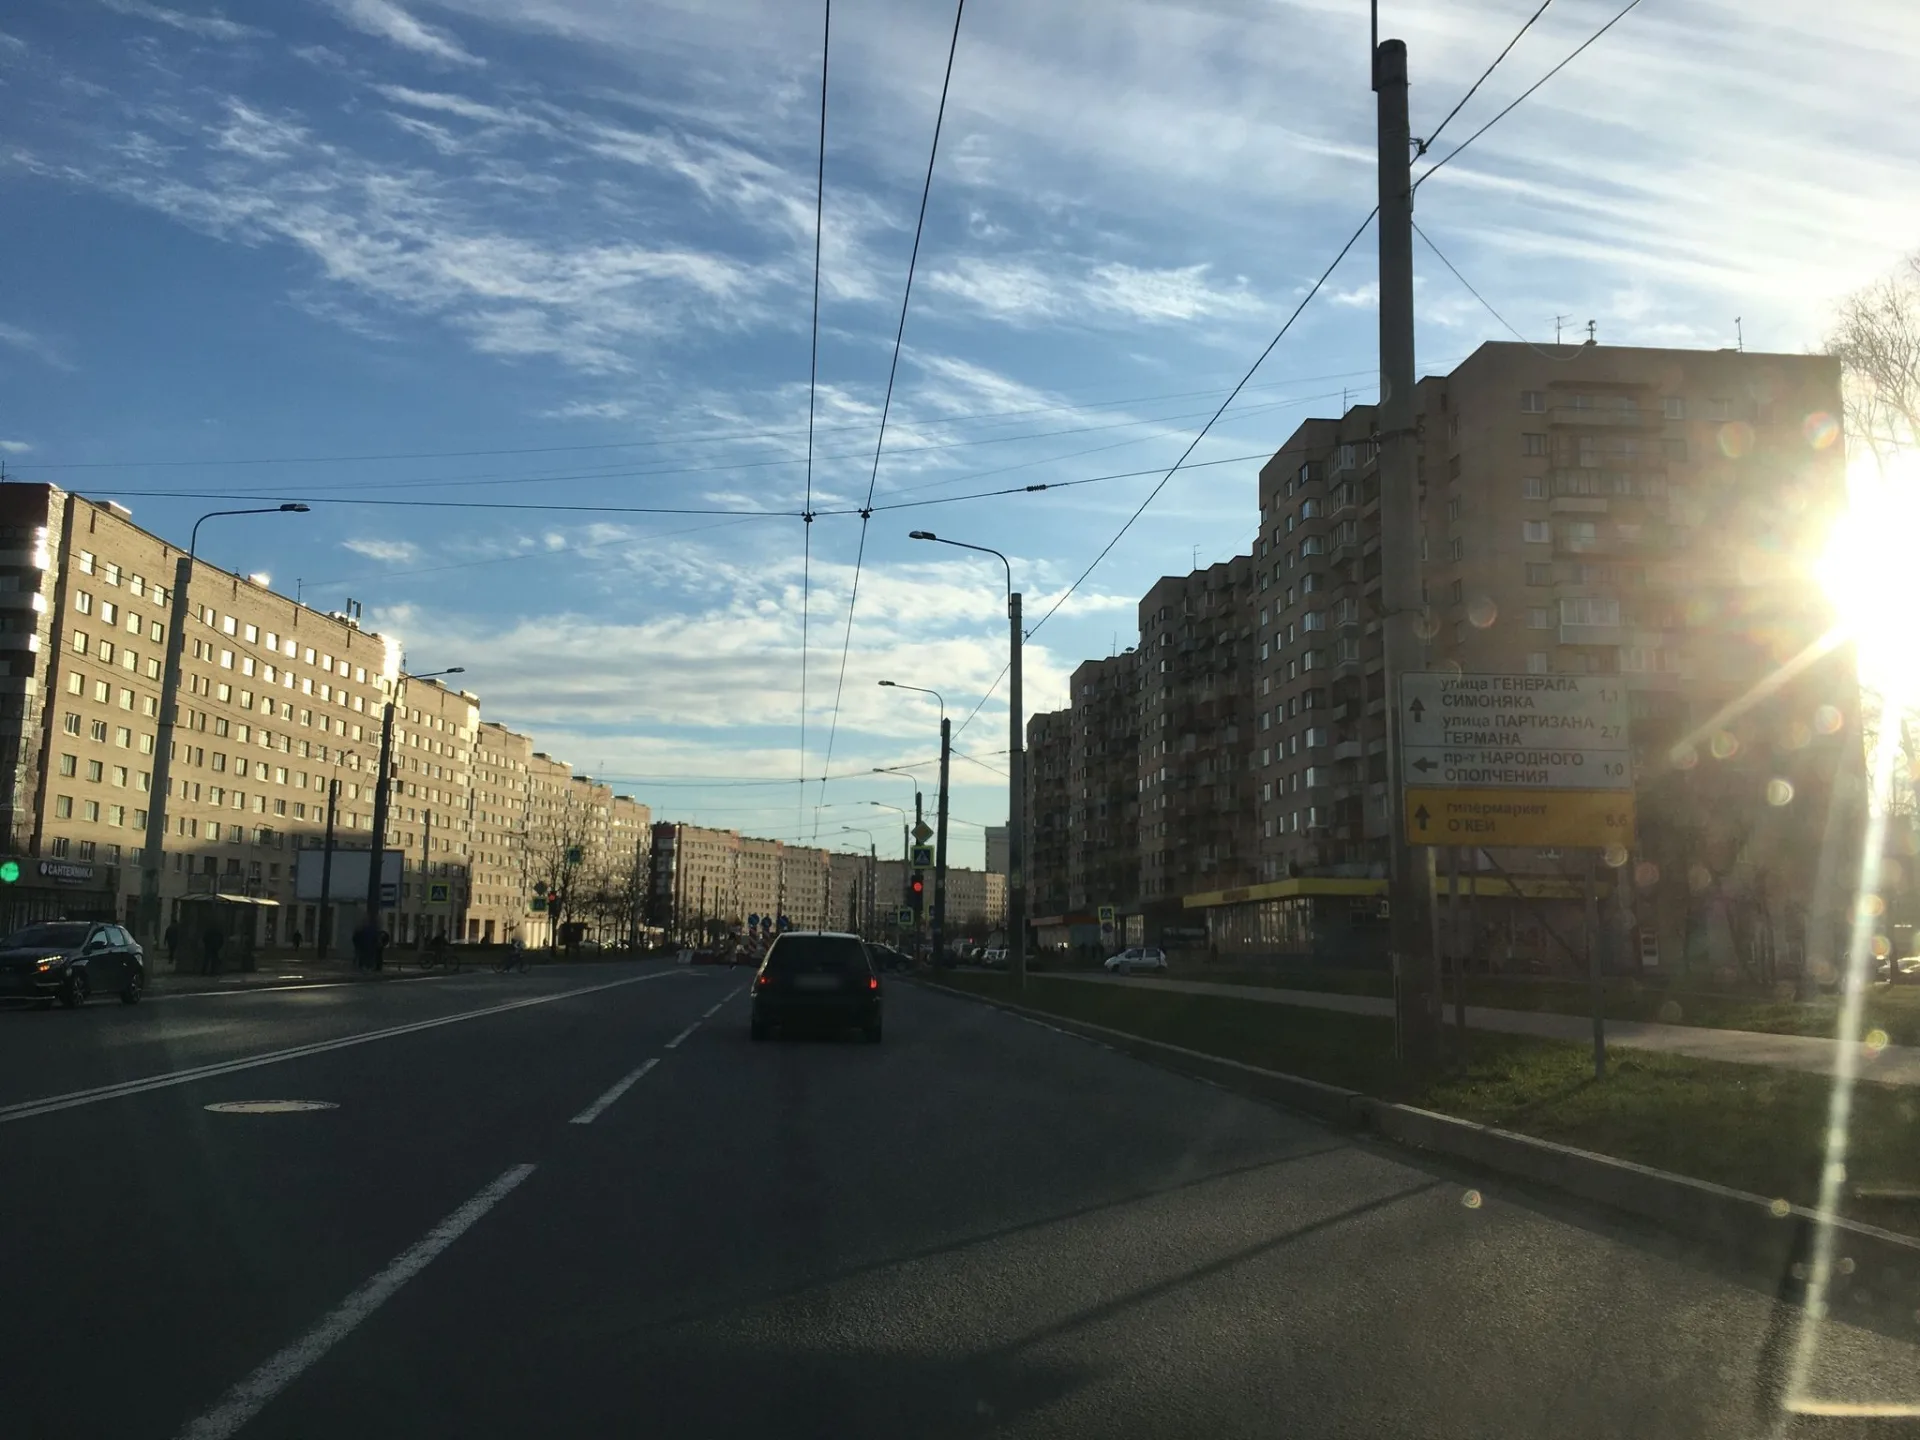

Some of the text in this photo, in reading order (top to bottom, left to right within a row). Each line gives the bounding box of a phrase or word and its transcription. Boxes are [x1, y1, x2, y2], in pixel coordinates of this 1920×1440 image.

[1440, 677, 1580, 692] улица ГЕНЕРАЛА
[1442, 693, 1536, 709] СИМОНЯКА
[1442, 714, 1595, 729] улица ПАРТИЗАНА
[1444, 731, 1522, 745] ГЕРМАНА
[1600, 725, 1621, 740] 2,7
[1444, 752, 1585, 767] пр-т НАРОДНОГО
[1444, 768, 1549, 783] ОПОЛЧЕНИЯ
[1603, 762, 1624, 778] 1,0
[1446, 802, 1548, 818] гипермаркет
[47, 863, 94, 878] САНТЕХНИКА
